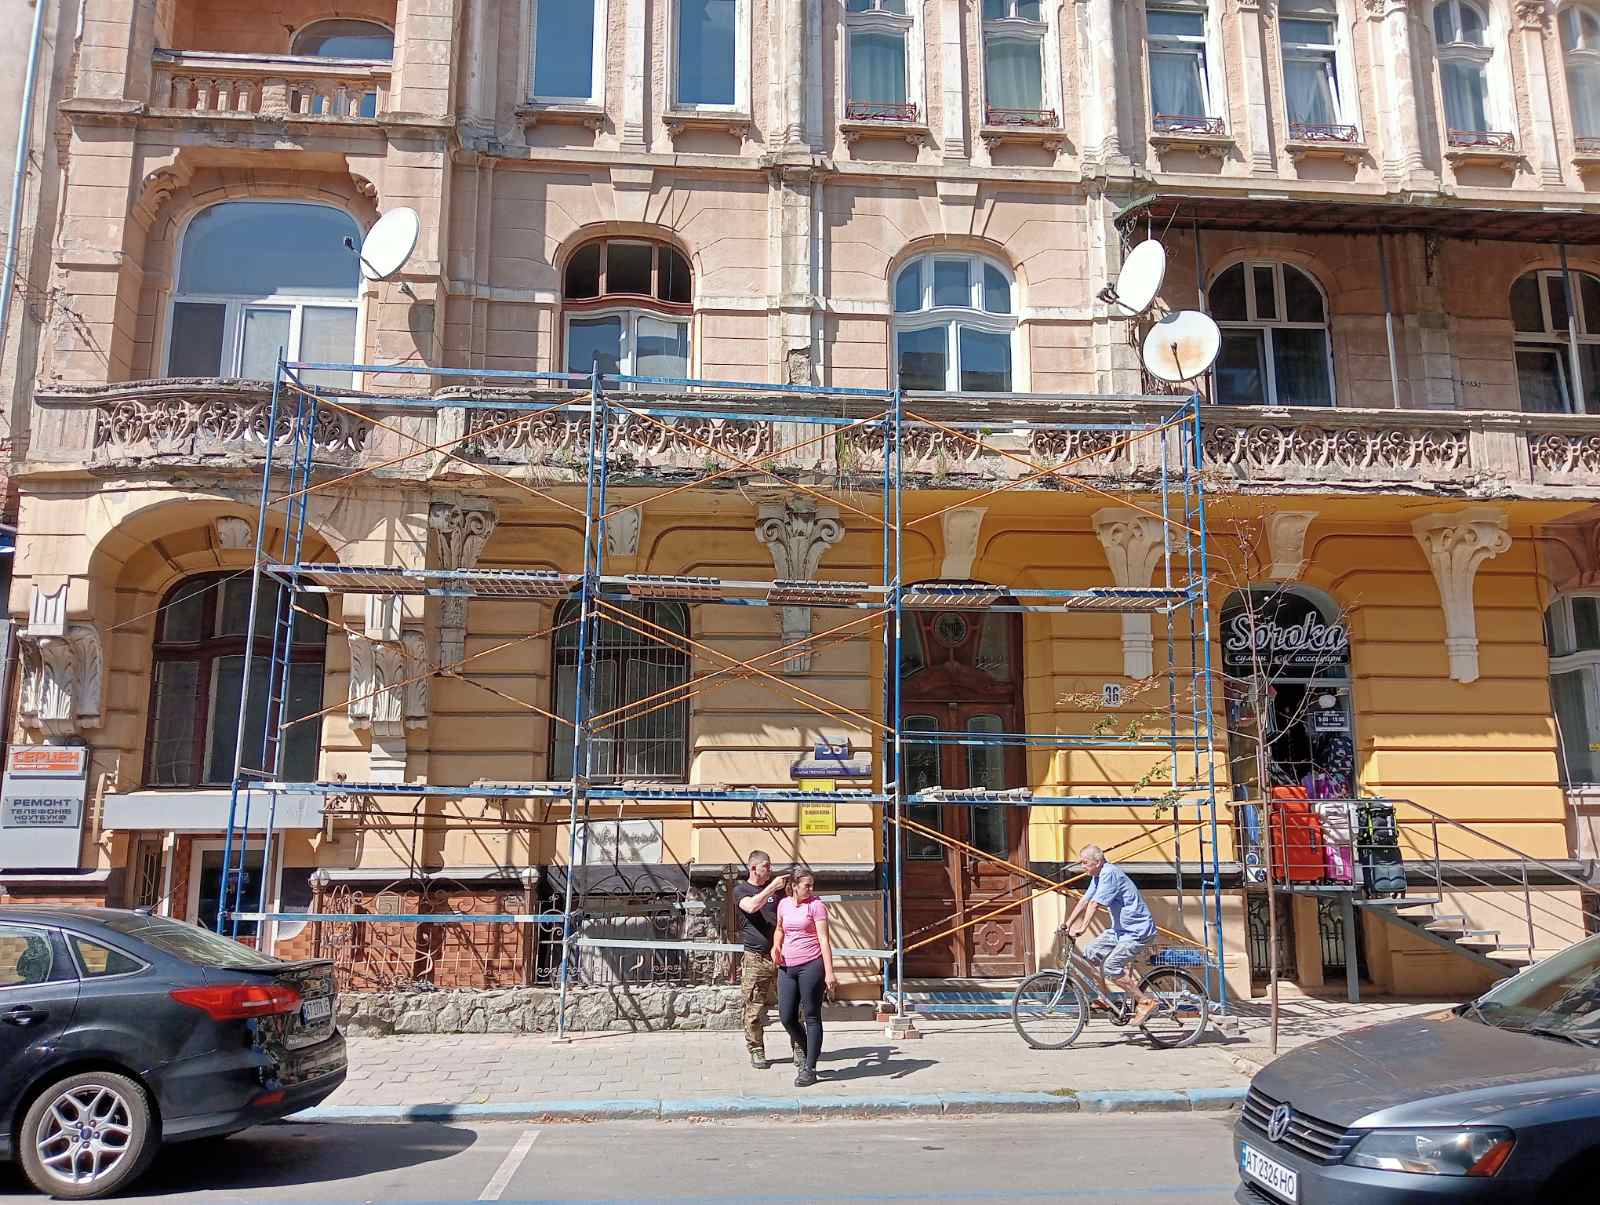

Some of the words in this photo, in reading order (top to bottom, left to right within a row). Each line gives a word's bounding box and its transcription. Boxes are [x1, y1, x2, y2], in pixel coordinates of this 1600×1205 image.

[1227, 611, 1348, 650] Soroka
[1295, 655, 1342, 665] аксесуари
[1105, 686, 1119, 704] 36
[13, 799, 72, 807] РЕМОНТ
